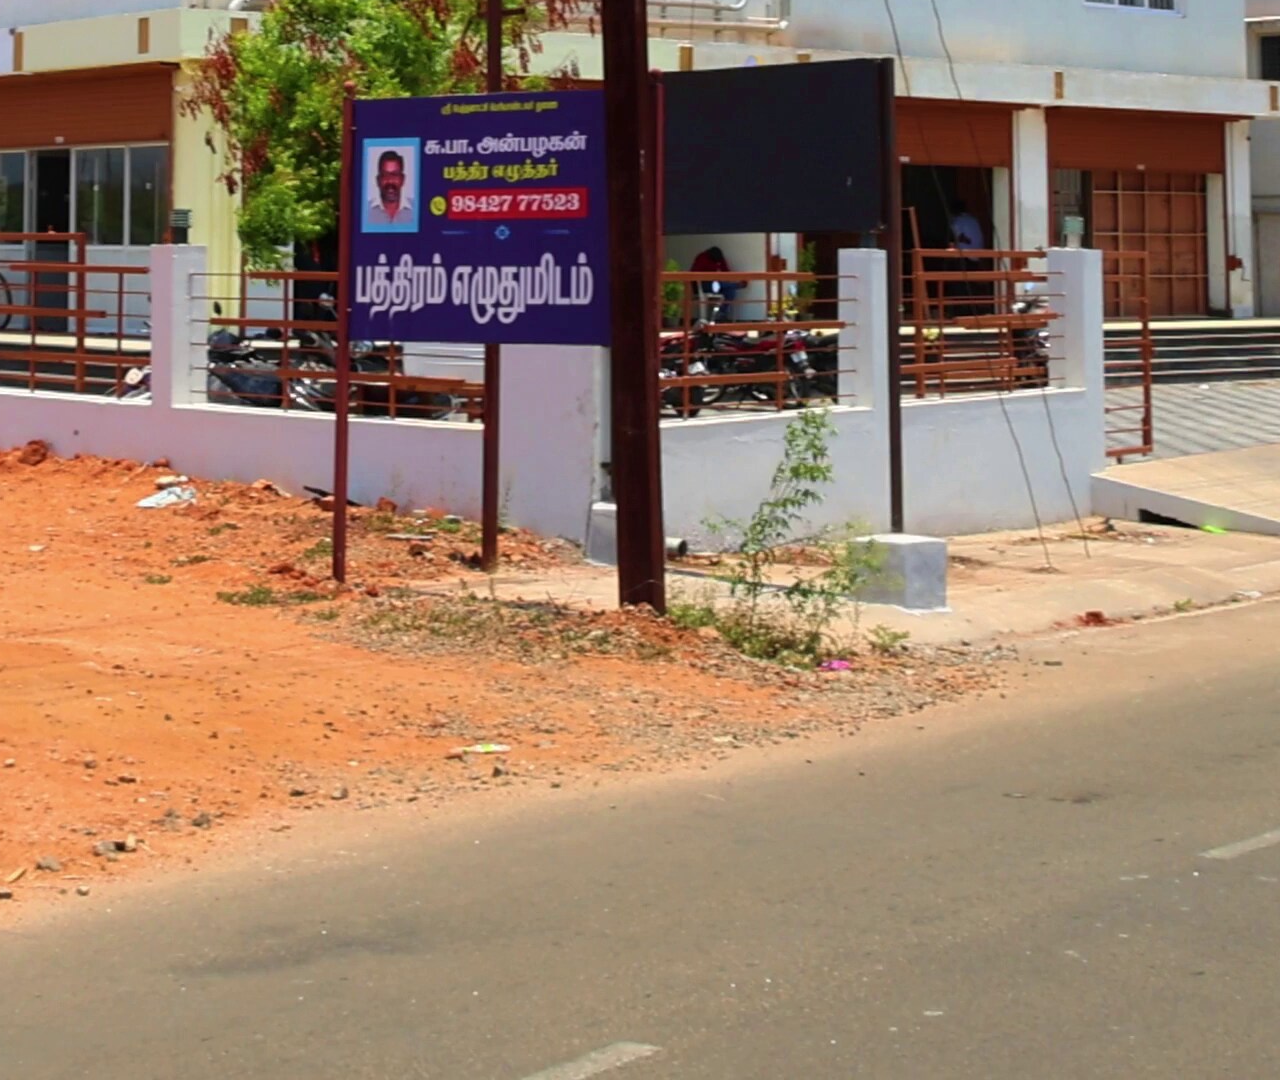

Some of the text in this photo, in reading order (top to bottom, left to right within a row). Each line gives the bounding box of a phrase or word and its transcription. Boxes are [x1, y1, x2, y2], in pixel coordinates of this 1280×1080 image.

[477, 130, 588, 158] அன்பழகன்
[492, 157, 559, 183] எழுத்தர்
[451, 193, 580, 213] 98427 77523
[355, 252, 593, 324] பத்திரம் எழுதுமிடம்
